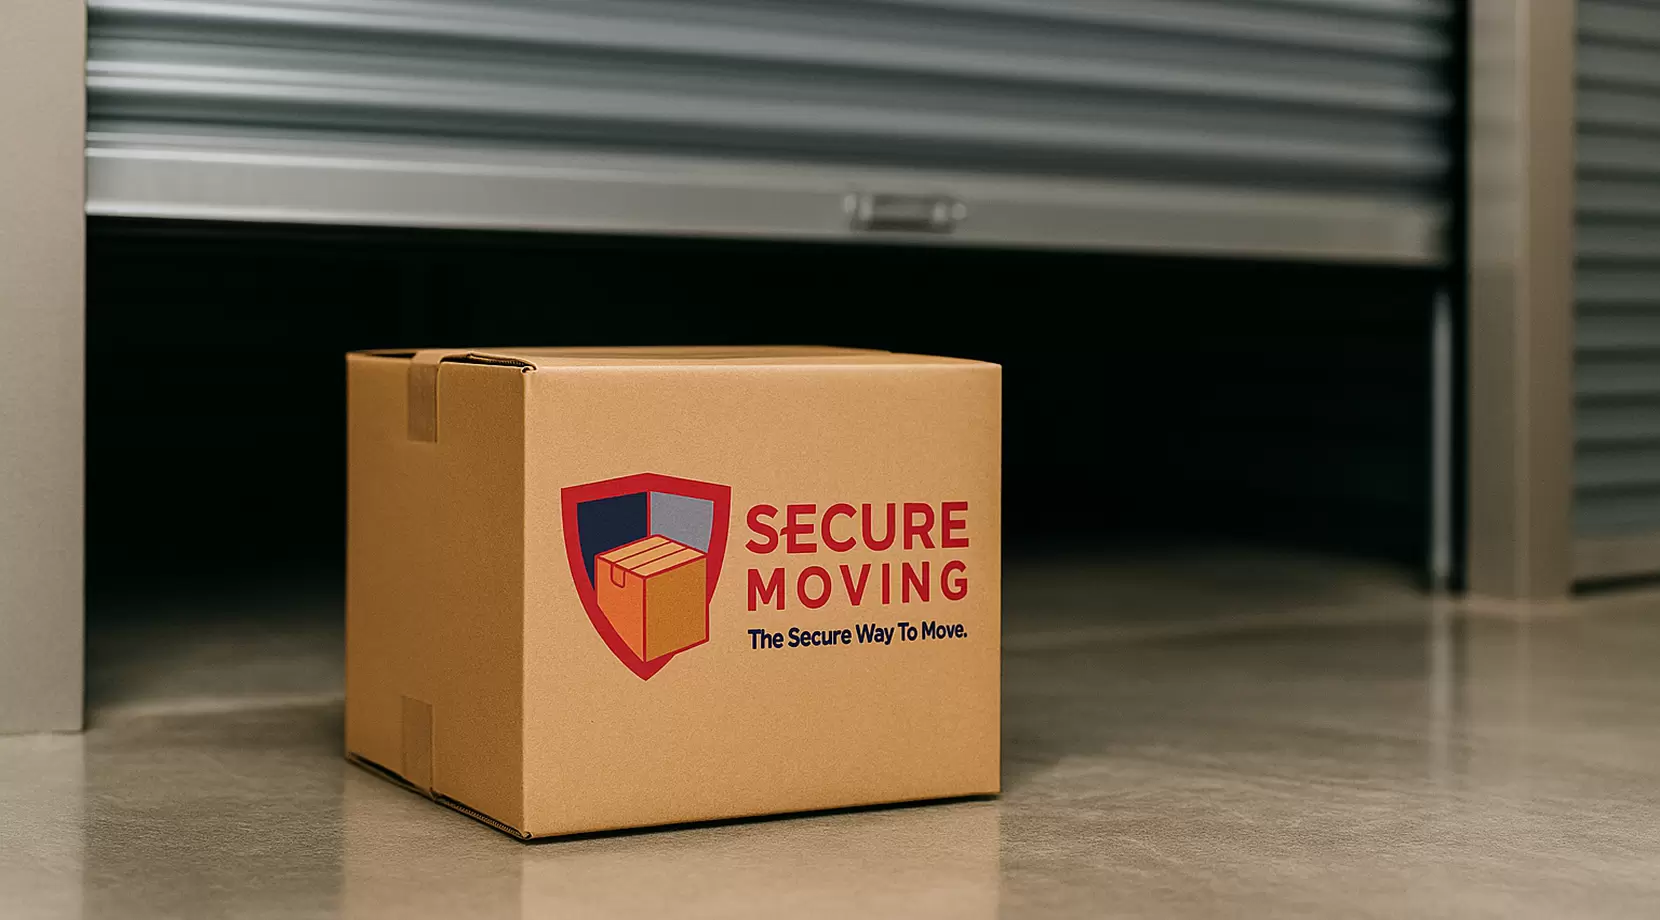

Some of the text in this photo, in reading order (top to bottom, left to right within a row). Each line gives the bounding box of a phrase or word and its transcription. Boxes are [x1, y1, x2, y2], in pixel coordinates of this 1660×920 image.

[745, 502, 969, 554] SECURE
[747, 560, 968, 611] MOVING
[748, 621, 967, 649] The Secure Way To Move.
